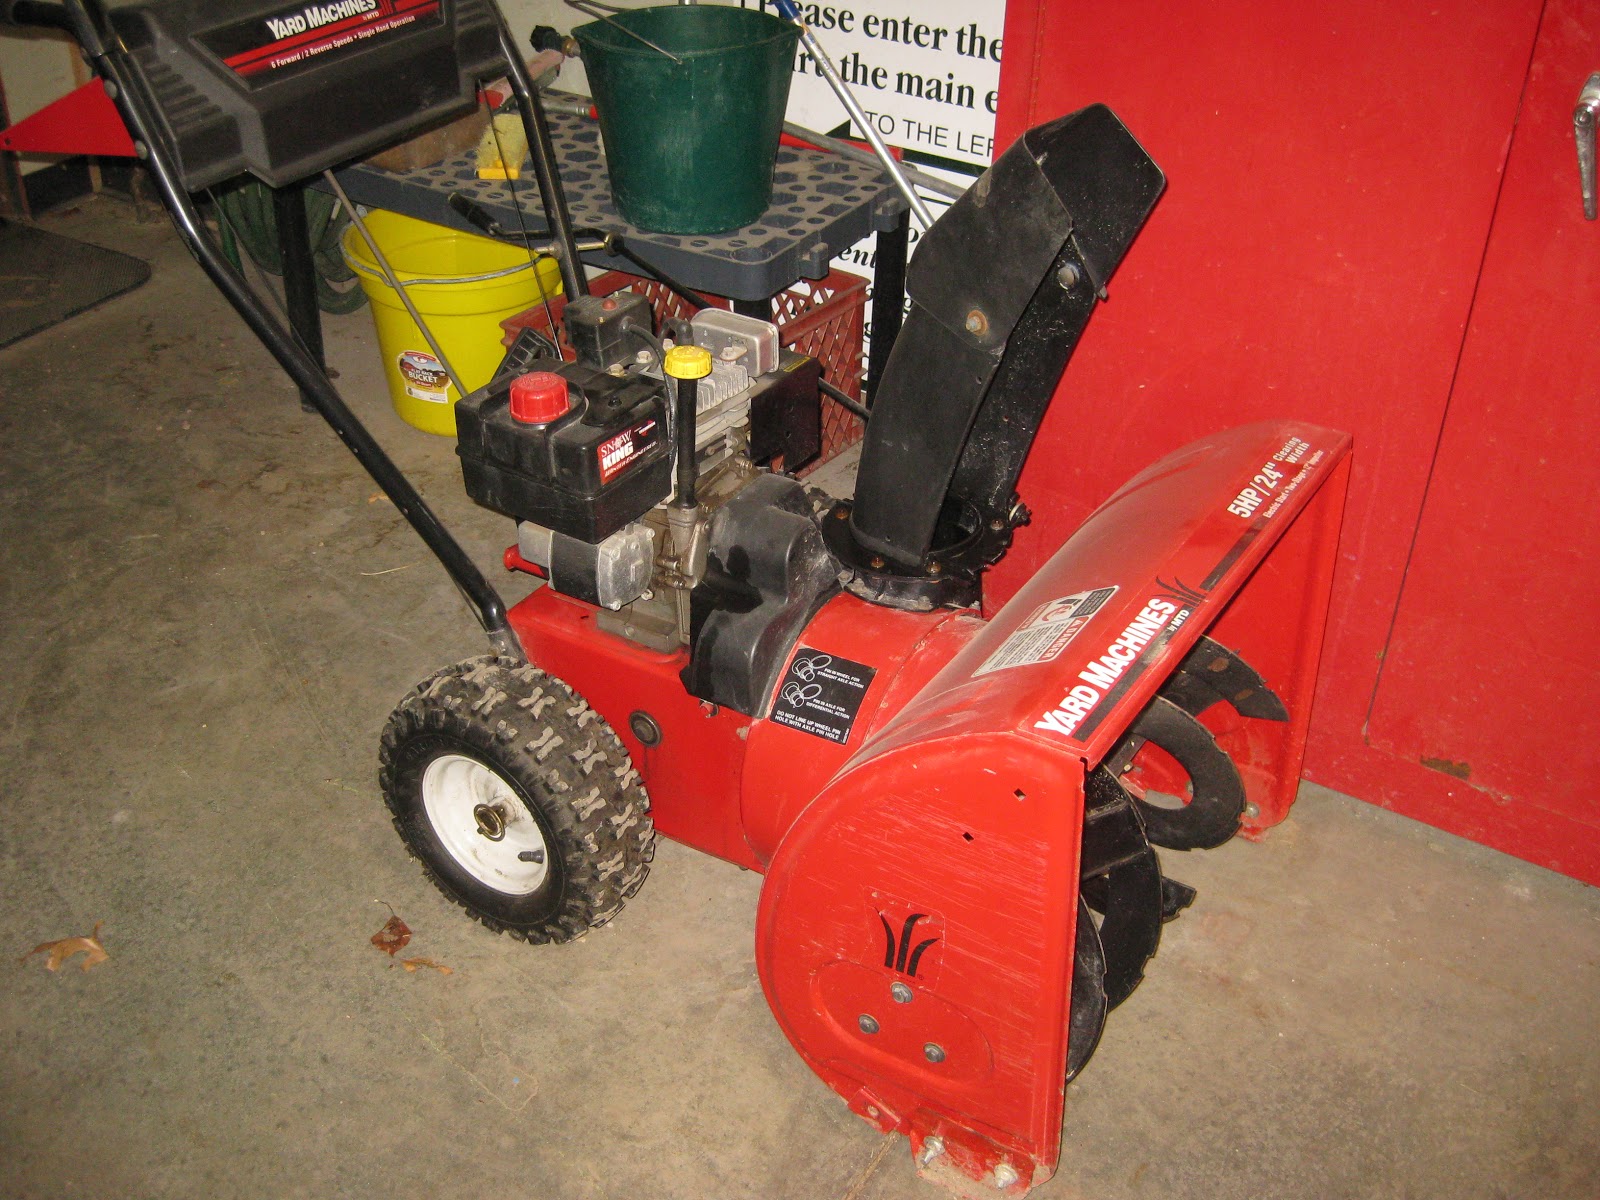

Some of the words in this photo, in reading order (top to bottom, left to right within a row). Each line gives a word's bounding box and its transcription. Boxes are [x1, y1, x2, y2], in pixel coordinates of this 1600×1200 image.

[266, 13, 307, 40] YARD
[304, 0, 377, 29] MACHINES
[366, 11, 380, 20] MTD
[271, 61, 277, 69] 6
[277, 53, 302, 67] Forward
[305, 49, 310, 58] 2
[310, 43, 333, 56] Reverse
[333, 36, 354, 49] Speeds
[358, 29, 376, 40] Single
[376, 23, 390, 35] Hand
[390, 15, 416, 29] Operation
[862, 14, 948, 51] enter
[956, 23, 1003, 63] the
[840, 52, 888, 90] the
[895, 72, 975, 110] main
[865, 111, 895, 135] TO
[903, 118, 949, 148] THE
[408, 371, 438, 383] BUCKET
[602, 441, 634, 471] KING
[1273, 437, 1302, 461] Clearing
[1285, 442, 1310, 463] Width
[1173, 609, 1190, 627] MTD
[1042, 626, 1078, 658] DANGER
[1034, 684, 1100, 736] YARD
[1077, 598, 1177, 690] MACHINES
[848, 680, 864, 689] ACTION
[785, 711, 795, 720] NOT
[795, 714, 807, 723] LINE
[807, 717, 815, 726] UP
[814, 719, 831, 731] WHEEL
[831, 725, 842, 735] PIN
[806, 702, 834, 714] DIFFERENTIAL
[834, 710, 850, 719] ACTION
[774, 715, 788, 723] HOLE
[788, 719, 802, 728] WITH
[801, 723, 815, 733] AXLE
[815, 728, 825, 736] PIN
[825, 731, 840, 740] HOLE
